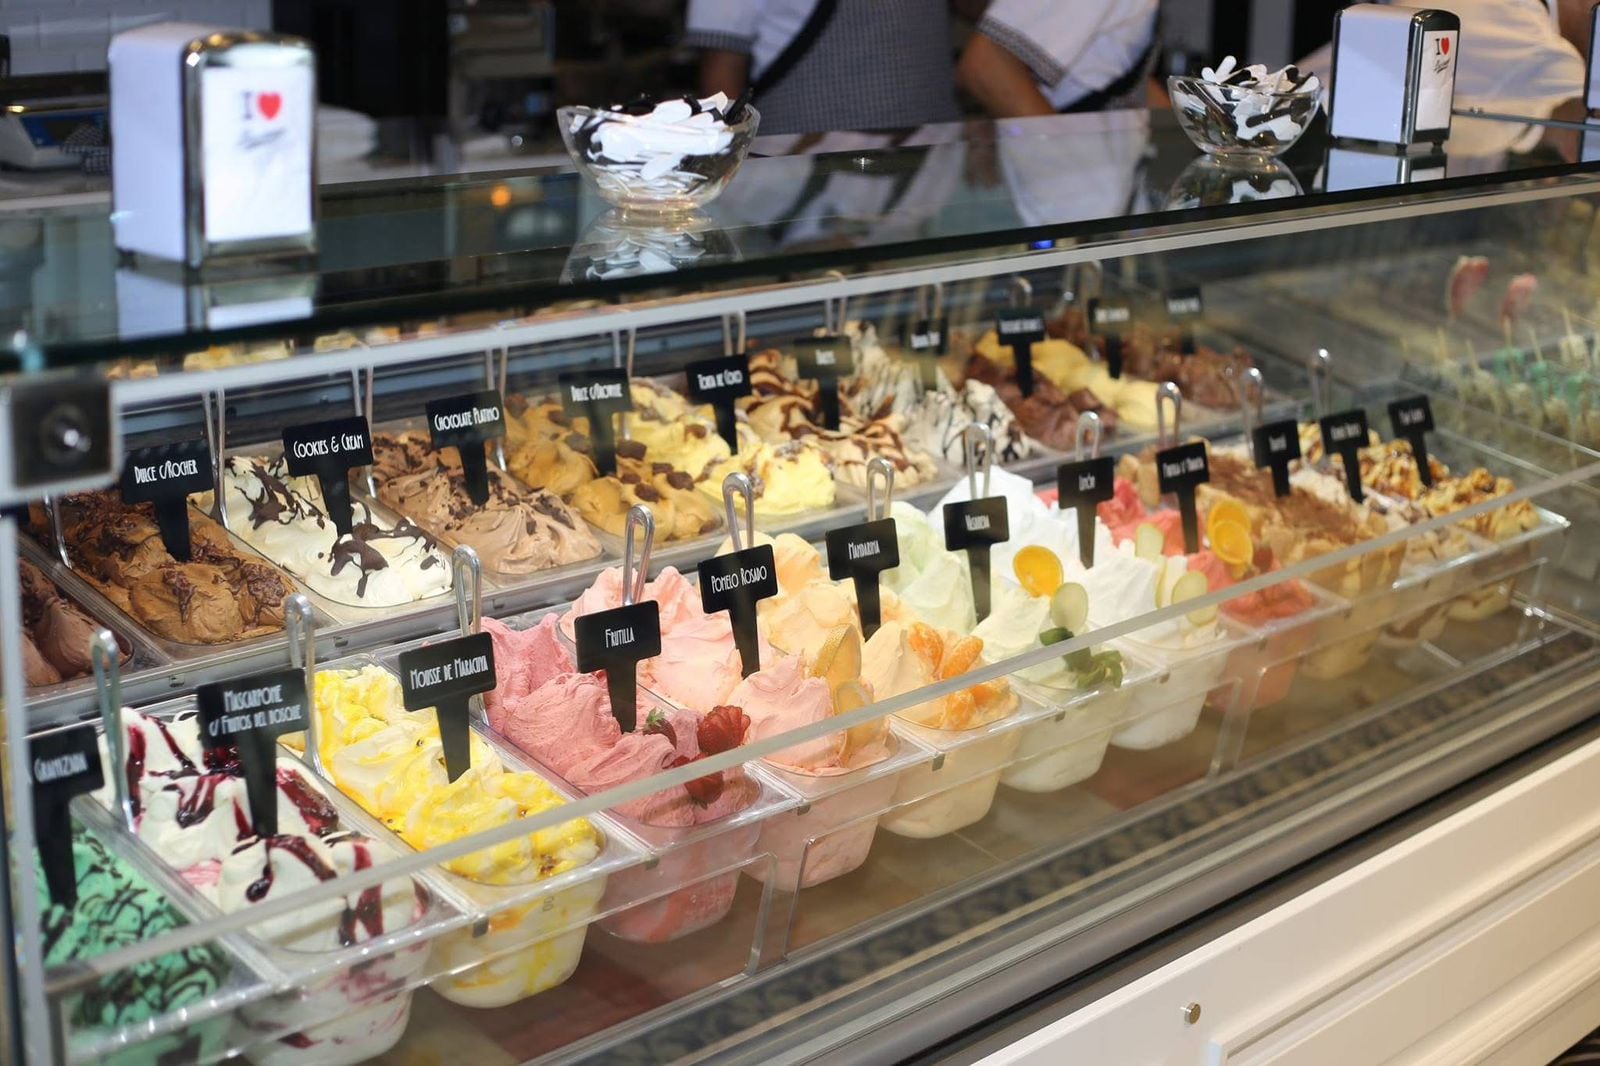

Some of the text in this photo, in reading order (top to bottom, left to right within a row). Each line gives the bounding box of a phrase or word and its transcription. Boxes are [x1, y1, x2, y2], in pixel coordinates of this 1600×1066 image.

[1435, 38, 1441, 55] I
[242, 91, 253, 120] I
[434, 407, 499, 431] CHOCOLATE PLATINO
[293, 433, 364, 458] COOKIES & CREAM
[134, 466, 157, 484] DULCE
[848, 540, 880, 560] MANDARINA
[711, 565, 767, 594] POMELO ROSADO
[605, 627, 635, 648] FRUTILLA
[410, 655, 489, 690] MOUSSE DE MARACUYA
[224, 684, 284, 713] MASCARPONE
[222, 713, 252, 734] FRUTOS
[254, 710, 267, 728] DEL
[268, 704, 302, 724] BOSQUE
